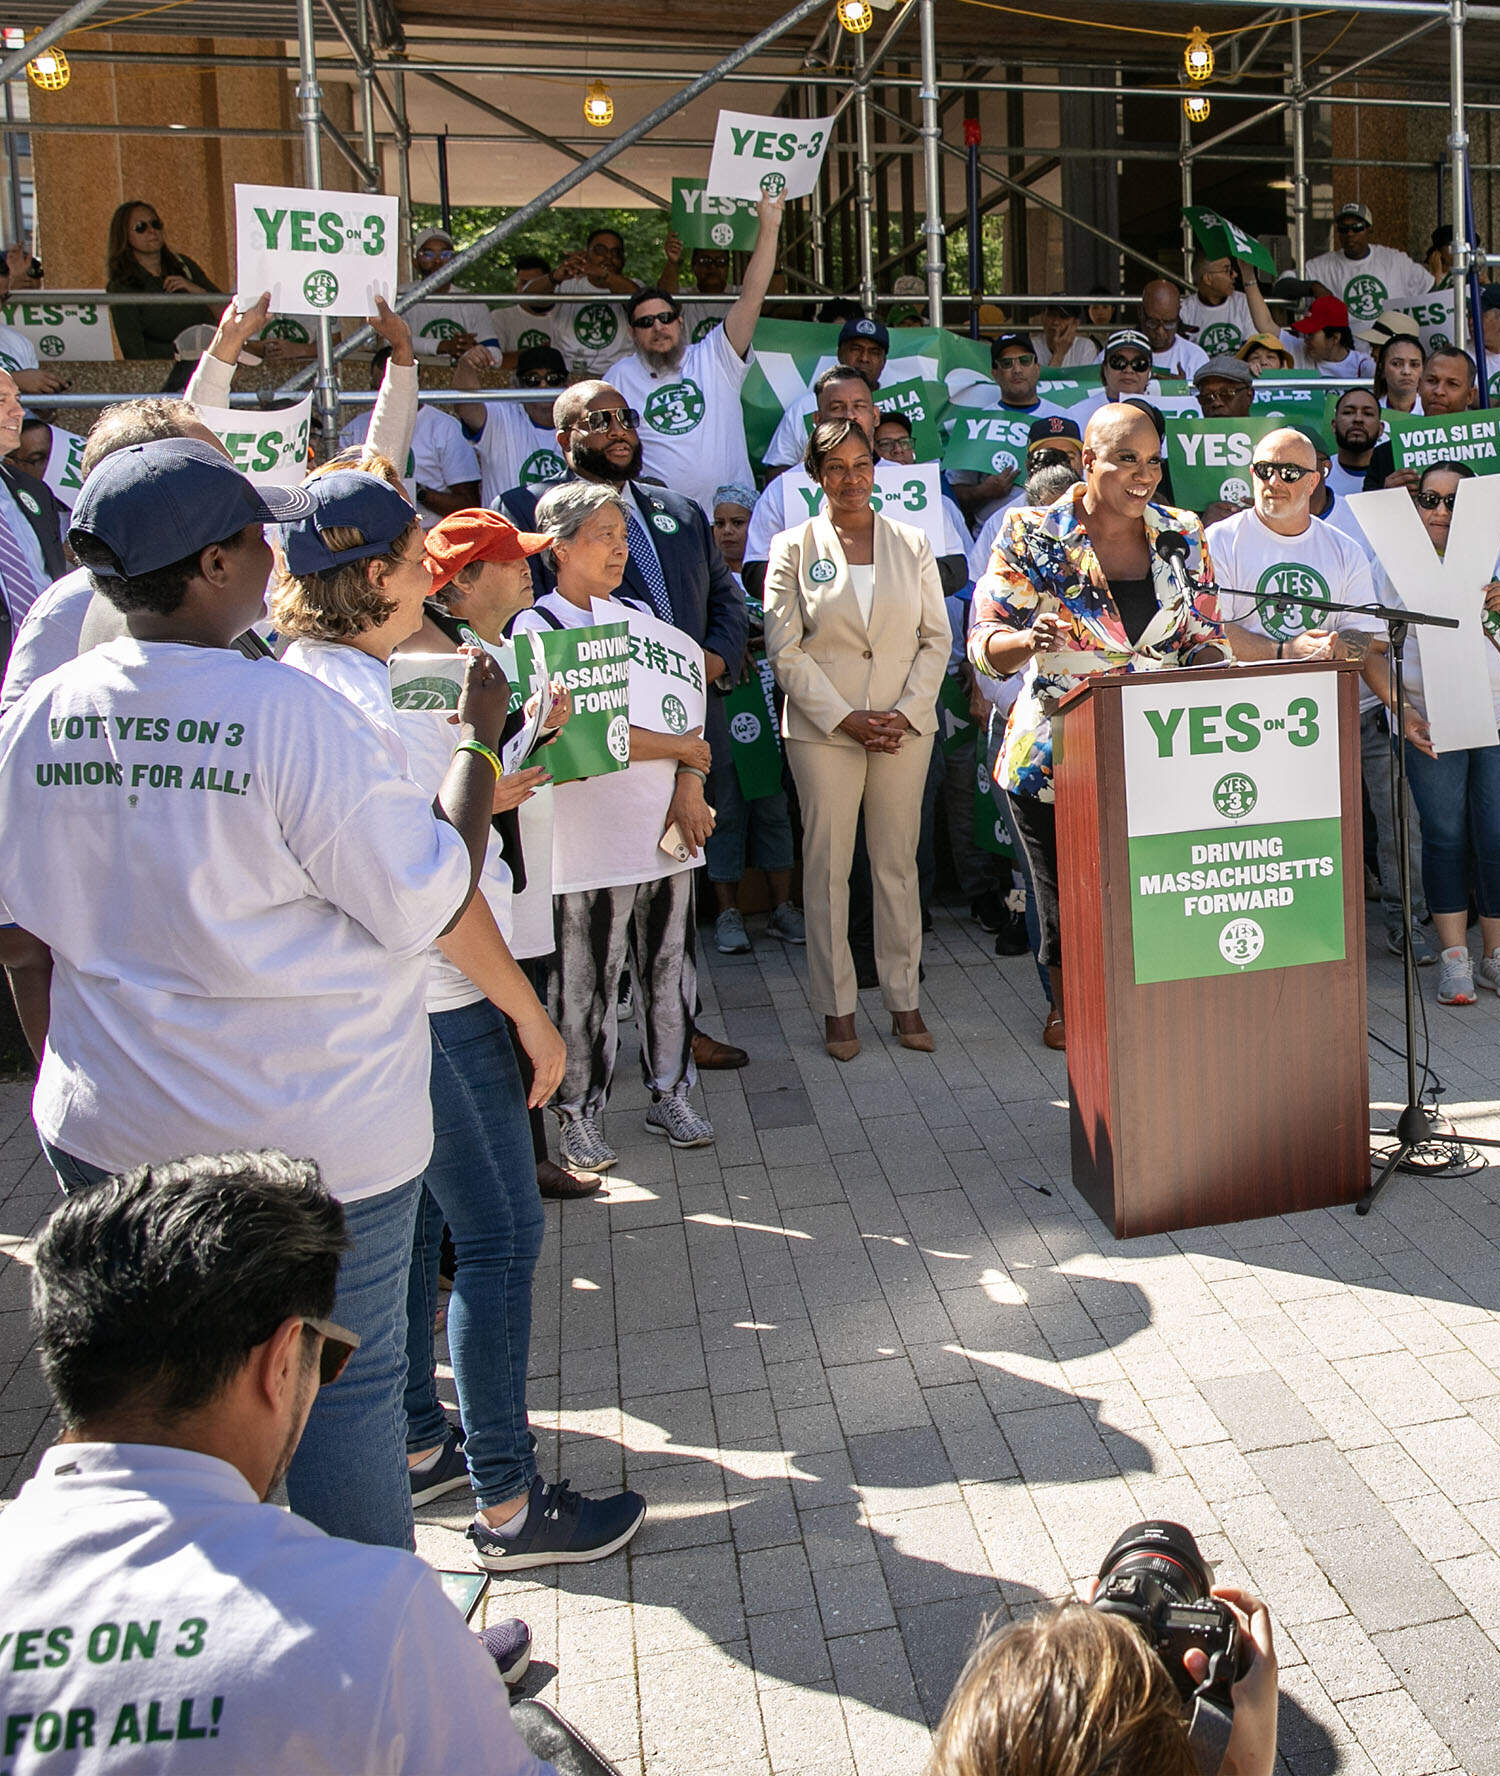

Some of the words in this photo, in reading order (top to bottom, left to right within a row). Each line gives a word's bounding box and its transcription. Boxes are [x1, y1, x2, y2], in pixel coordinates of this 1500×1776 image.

[731, 127, 798, 162] YES
[807, 131, 824, 158] 3
[254, 208, 344, 254] YES
[346, 229, 362, 240] ON
[363, 215, 386, 256] 3
[313, 274, 333, 287] YES
[1353, 280, 1377, 296] YES
[0, 304, 64, 326] YES
[65, 310, 78, 318] ON
[80, 304, 98, 327] 3
[1360, 294, 1375, 311] 3
[1208, 329, 1233, 344] YES
[667, 400, 688, 423] 3
[897, 390, 921, 409] LA
[966, 419, 1031, 448] YES
[1400, 428, 1448, 449] VOTA
[1450, 425, 1468, 442] SI
[1471, 422, 1496, 439] EN
[216, 431, 283, 473] ES
[282, 443, 296, 453] ON
[1177, 433, 1251, 468] YES
[1403, 442, 1497, 468] PREGUNTA
[885, 493, 901, 501] ON
[902, 480, 928, 512] 3
[1274, 572, 1314, 596] YES
[1283, 603, 1303, 629] 3
[664, 699, 682, 713] YES
[51, 716, 110, 740] VOT
[115, 717, 170, 742] YES
[177, 719, 221, 744] ON
[224, 723, 245, 747] 3
[1144, 702, 1262, 758] YES
[1263, 719, 1286, 731] ON
[1287, 697, 1320, 748] 3
[131, 764, 183, 789] FOR
[190, 767, 252, 796] ALL!
[1224, 778, 1247, 793] YES
[1229, 792, 1242, 810] 3
[1191, 837, 1284, 865] DRIVING
[1139, 856, 1335, 896] MASSACHUSETTS
[1184, 887, 1295, 917] FORWARD
[1230, 924, 1254, 939] YES
[1236, 938, 1249, 955] 3
[87, 1620, 162, 1665] ON
[175, 1617, 208, 1658] 3
[4, 1707, 96, 1757] FOR
[109, 1695, 225, 1747] ALL!
